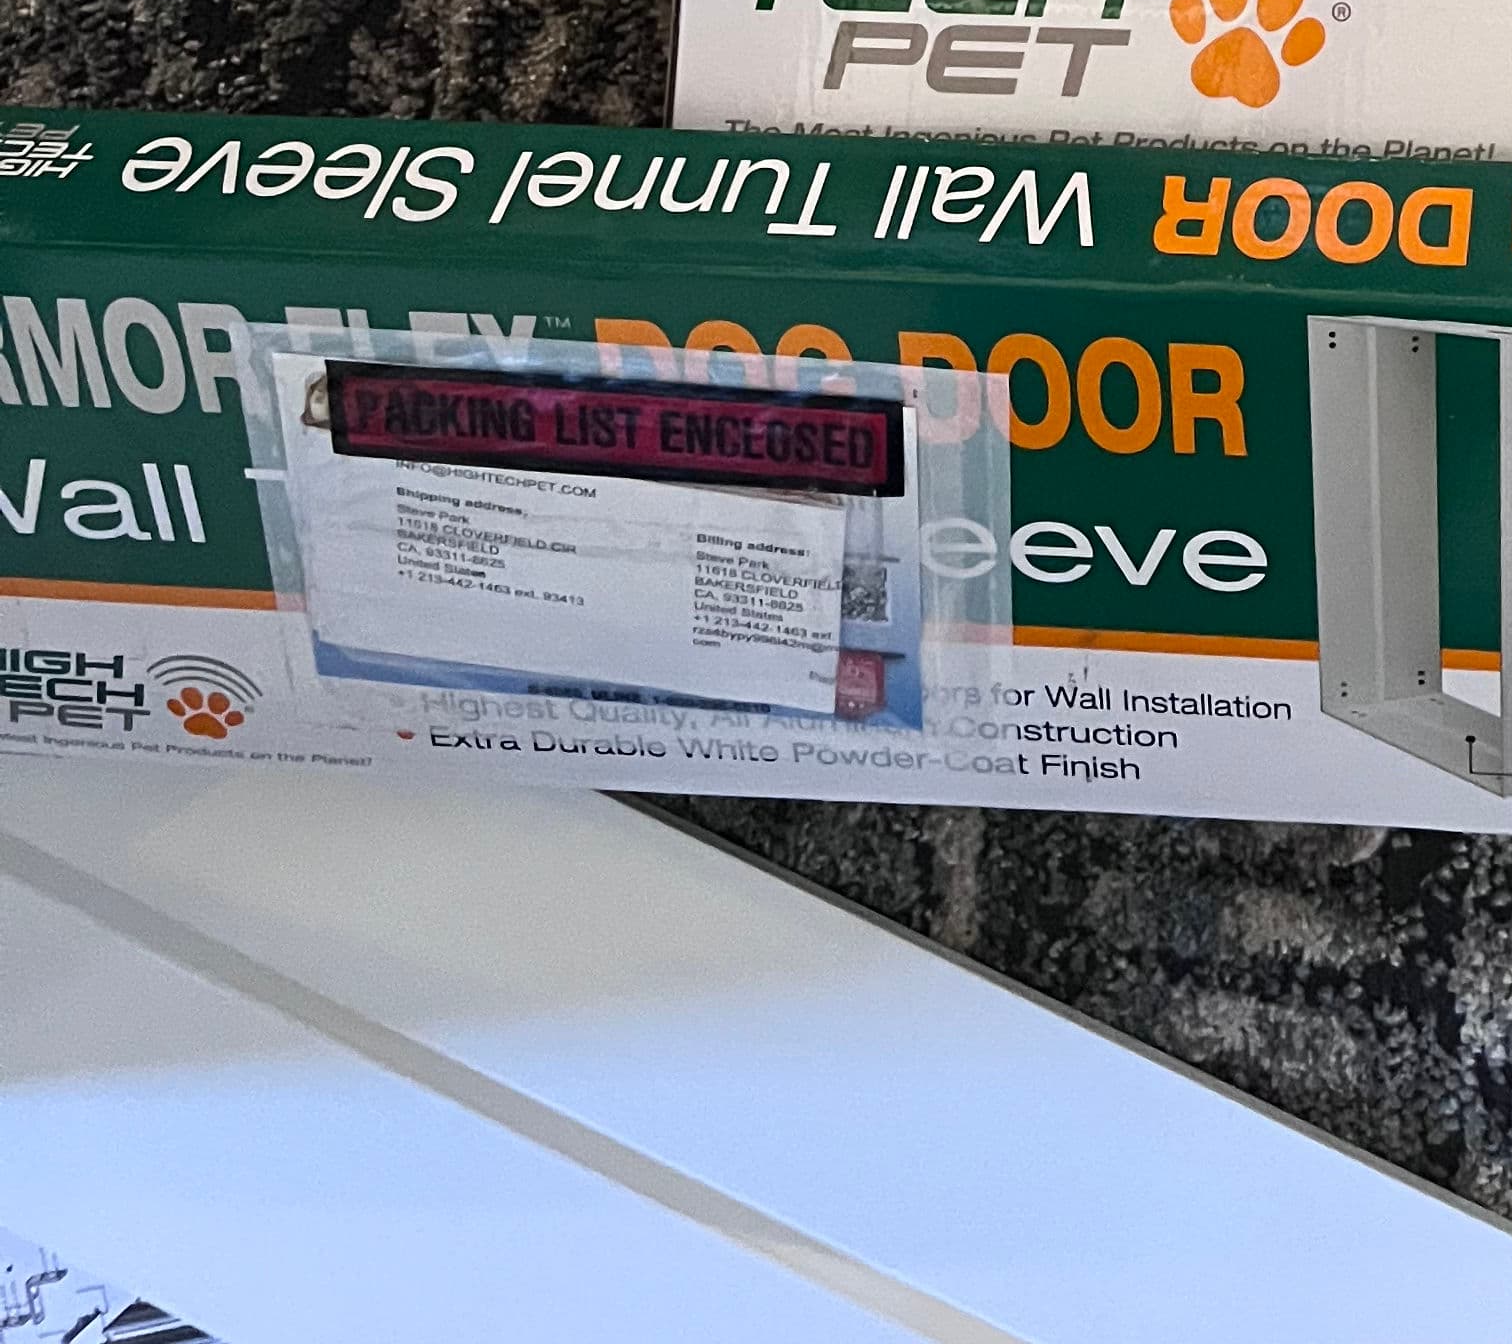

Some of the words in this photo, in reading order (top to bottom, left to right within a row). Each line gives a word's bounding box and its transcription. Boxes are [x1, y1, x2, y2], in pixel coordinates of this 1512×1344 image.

[823, 21, 1131, 97] PET
[121, 136, 475, 224] Sleeve
[490, 150, 838, 238] Tunnel
[874, 160, 1095, 248] Wall
[1152, 174, 1475, 267] DOOR
[353, 391, 537, 445] PACKING
[555, 401, 641, 452] LIST
[661, 410, 875, 470] ENCLOSED
[896, 329, 1249, 458] DOOR
[948, 717, 1178, 748] Construction
[992, 682, 1035, 707] for
[1045, 684, 1111, 711] Wall
[1124, 689, 1292, 720] Installation
[430, 725, 521, 752] Extra
[533, 728, 668, 758] Durable
[677, 736, 779, 763] White
[1042, 754, 1140, 780] Finish
